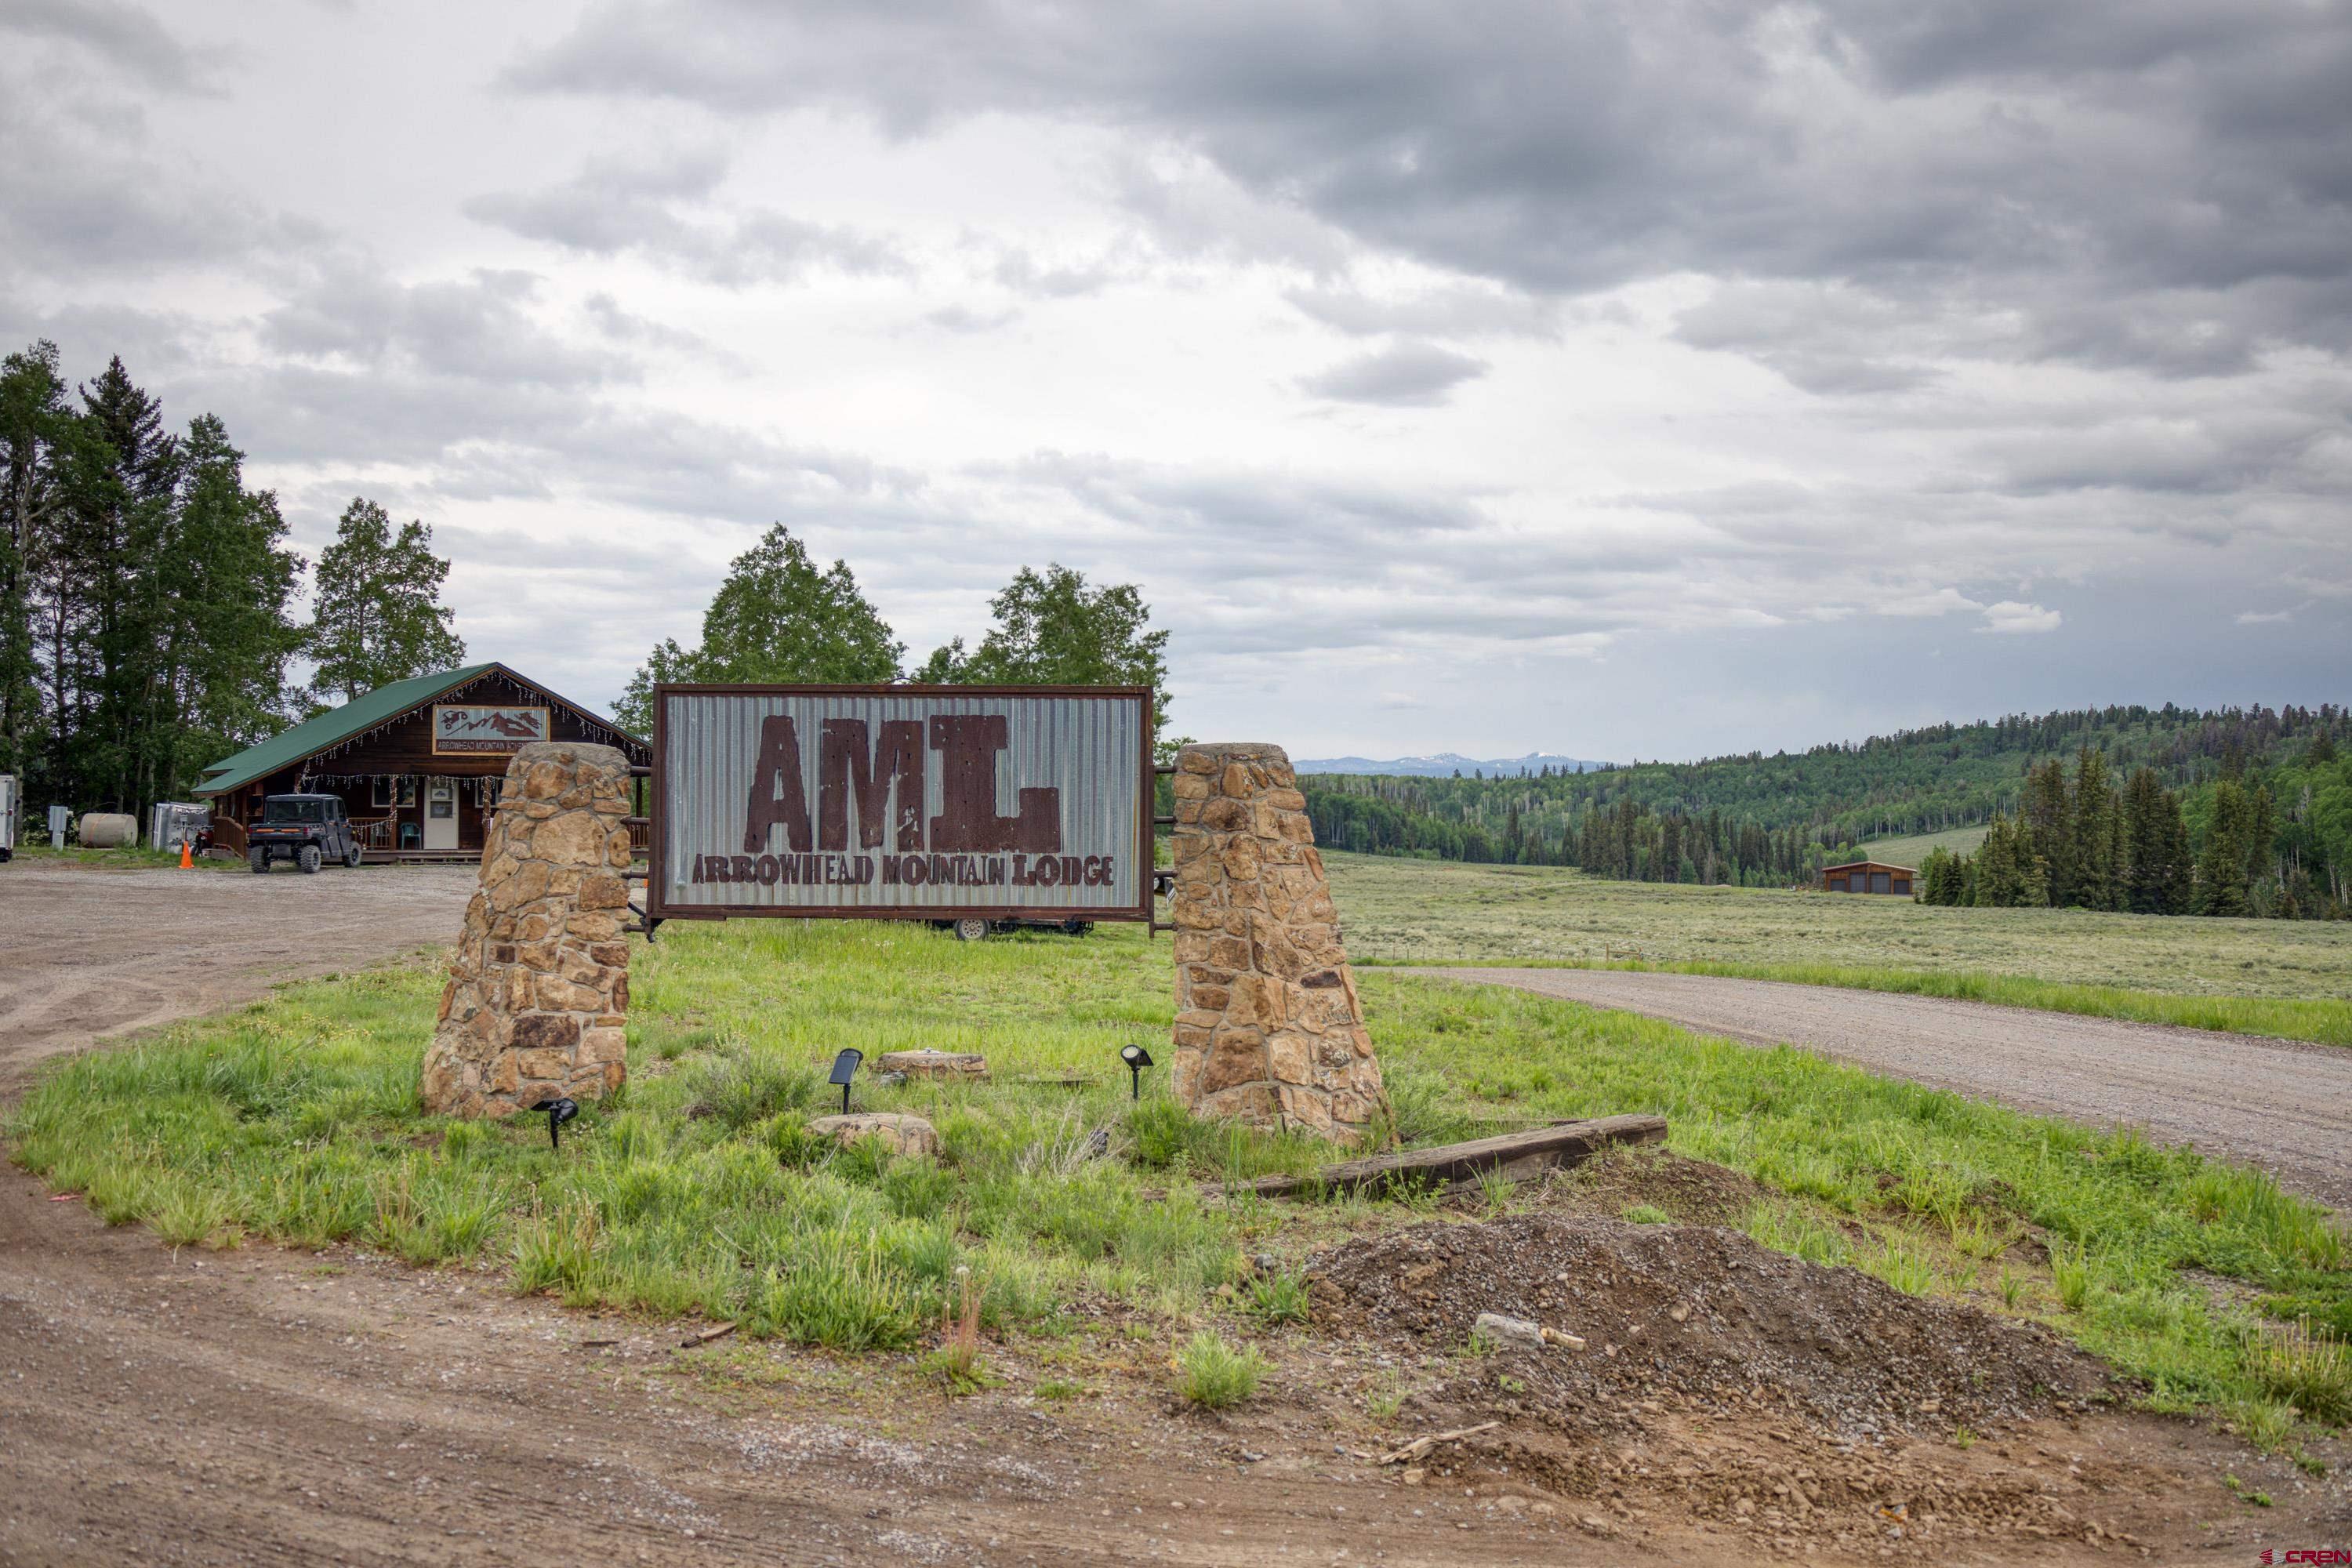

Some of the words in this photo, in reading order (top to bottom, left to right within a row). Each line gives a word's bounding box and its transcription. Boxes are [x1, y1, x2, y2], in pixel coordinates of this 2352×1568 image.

[438, 741, 474, 750] ARROWHEAD
[477, 741, 505, 750] MOUNTAIN
[745, 714, 1061, 853] AML
[691, 854, 874, 885] ARROWHEAD
[883, 855, 1005, 886] MOUNTAIN
[1011, 854, 1114, 887] LODGE
